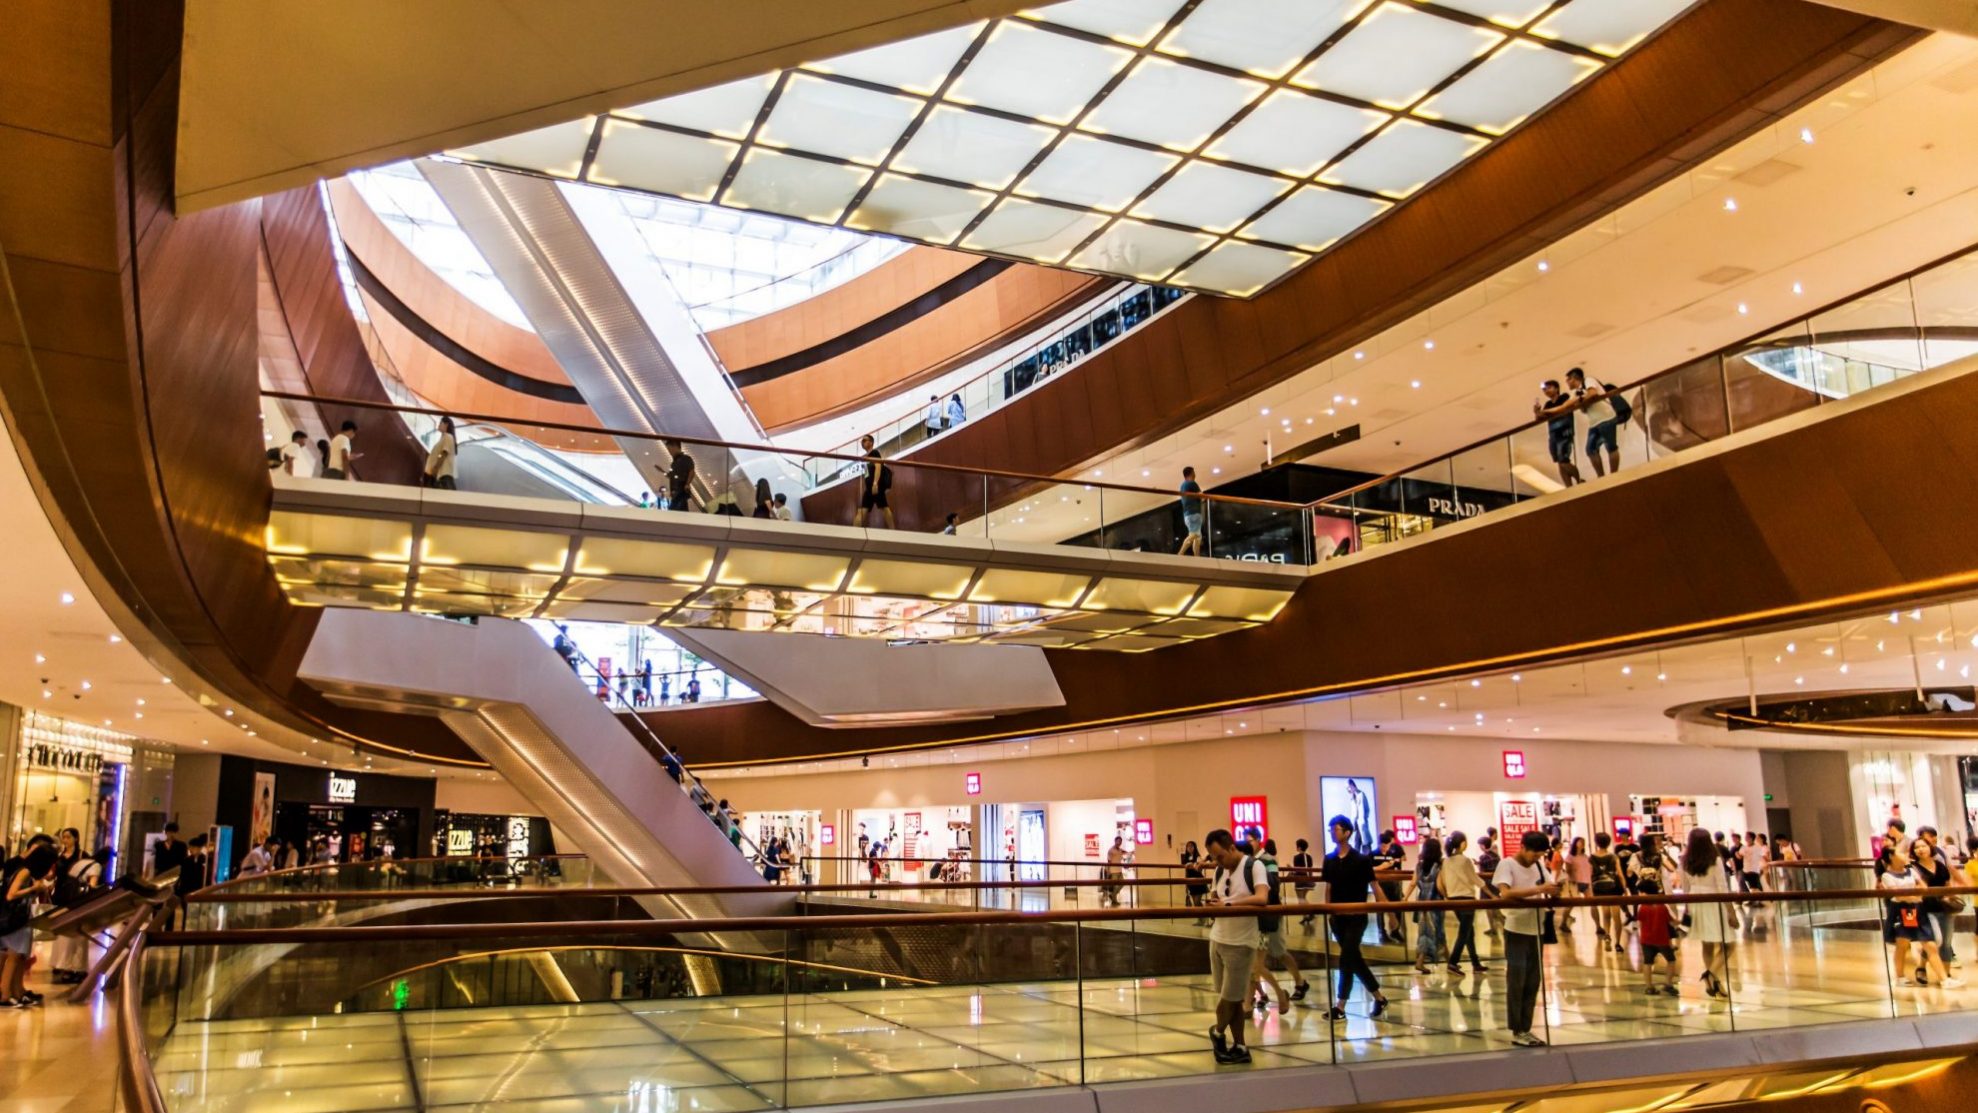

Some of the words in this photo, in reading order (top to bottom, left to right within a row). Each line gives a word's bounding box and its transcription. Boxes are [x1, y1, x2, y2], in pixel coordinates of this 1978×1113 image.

[1428, 498, 1486, 516] PRADA
[1233, 803, 1262, 823] UNI
[1504, 804, 1533, 818] SALE
[1396, 819, 1413, 829] UNI
[1397, 830, 1416, 842] QLO
